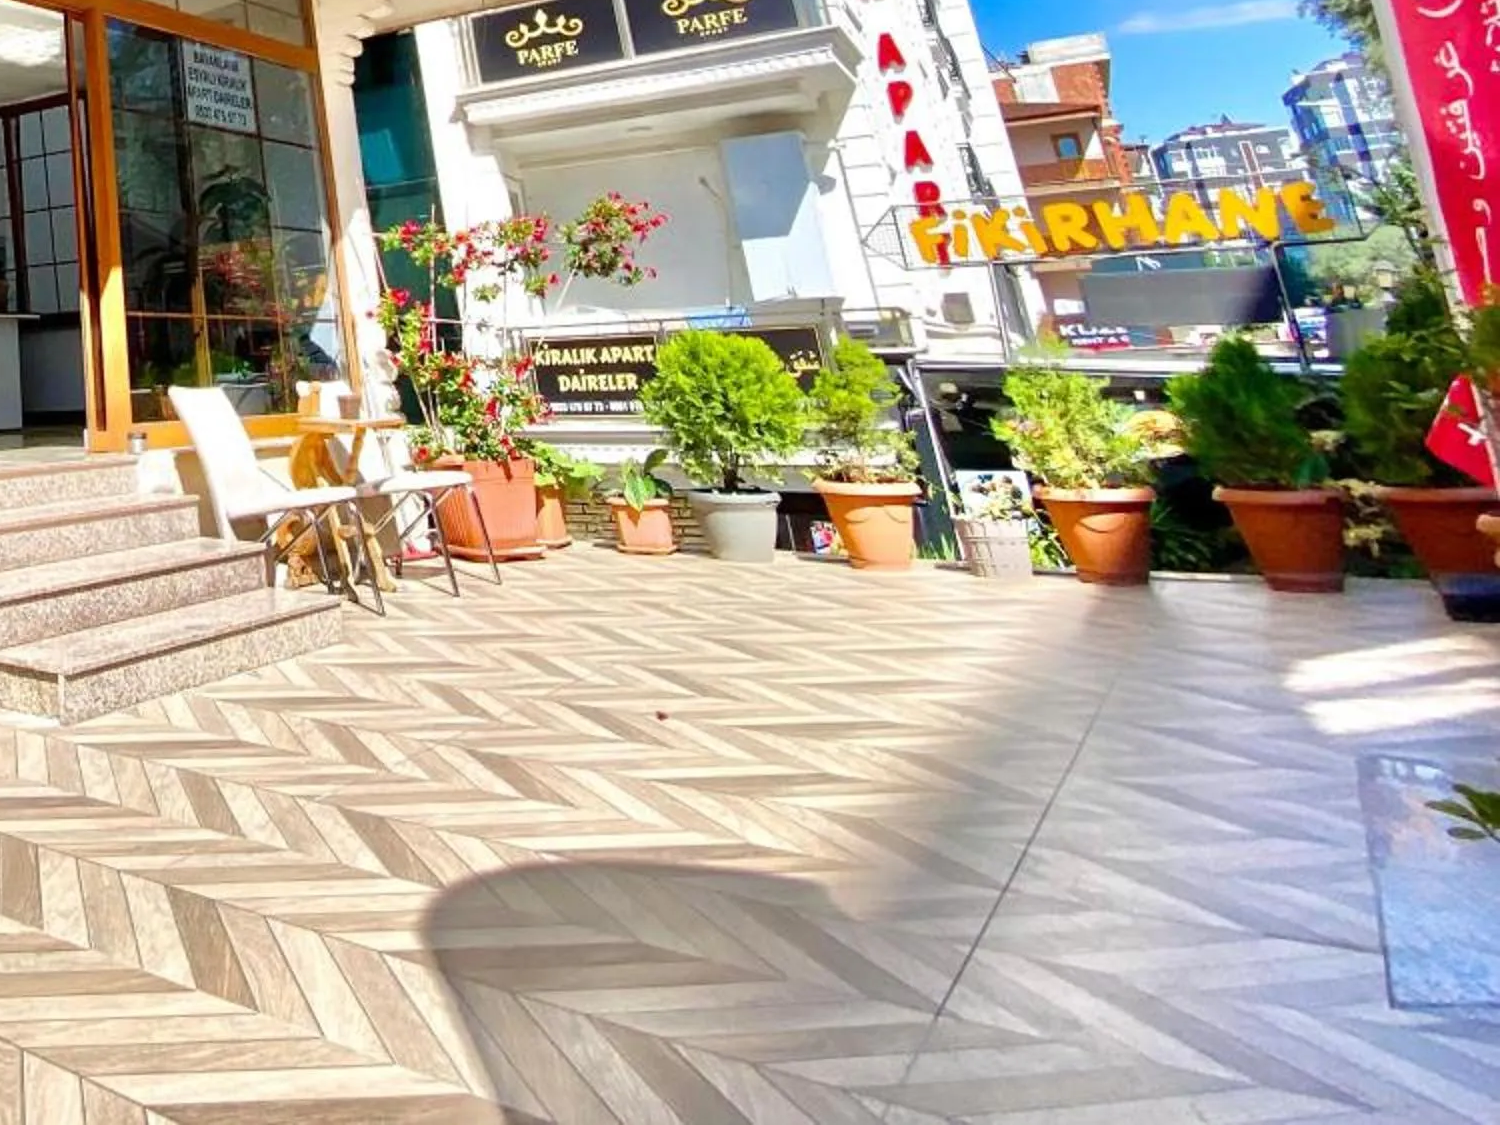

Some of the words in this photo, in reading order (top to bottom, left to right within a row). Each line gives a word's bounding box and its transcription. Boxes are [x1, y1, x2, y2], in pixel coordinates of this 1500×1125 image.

[675, 7, 749, 34] PARFE
[515, 39, 580, 65] PARFE
[877, 32, 953, 269] APART
[535, 343, 598, 366] KİRALIK
[600, 344, 655, 364] APART
[558, 368, 639, 392] DAİRELER
